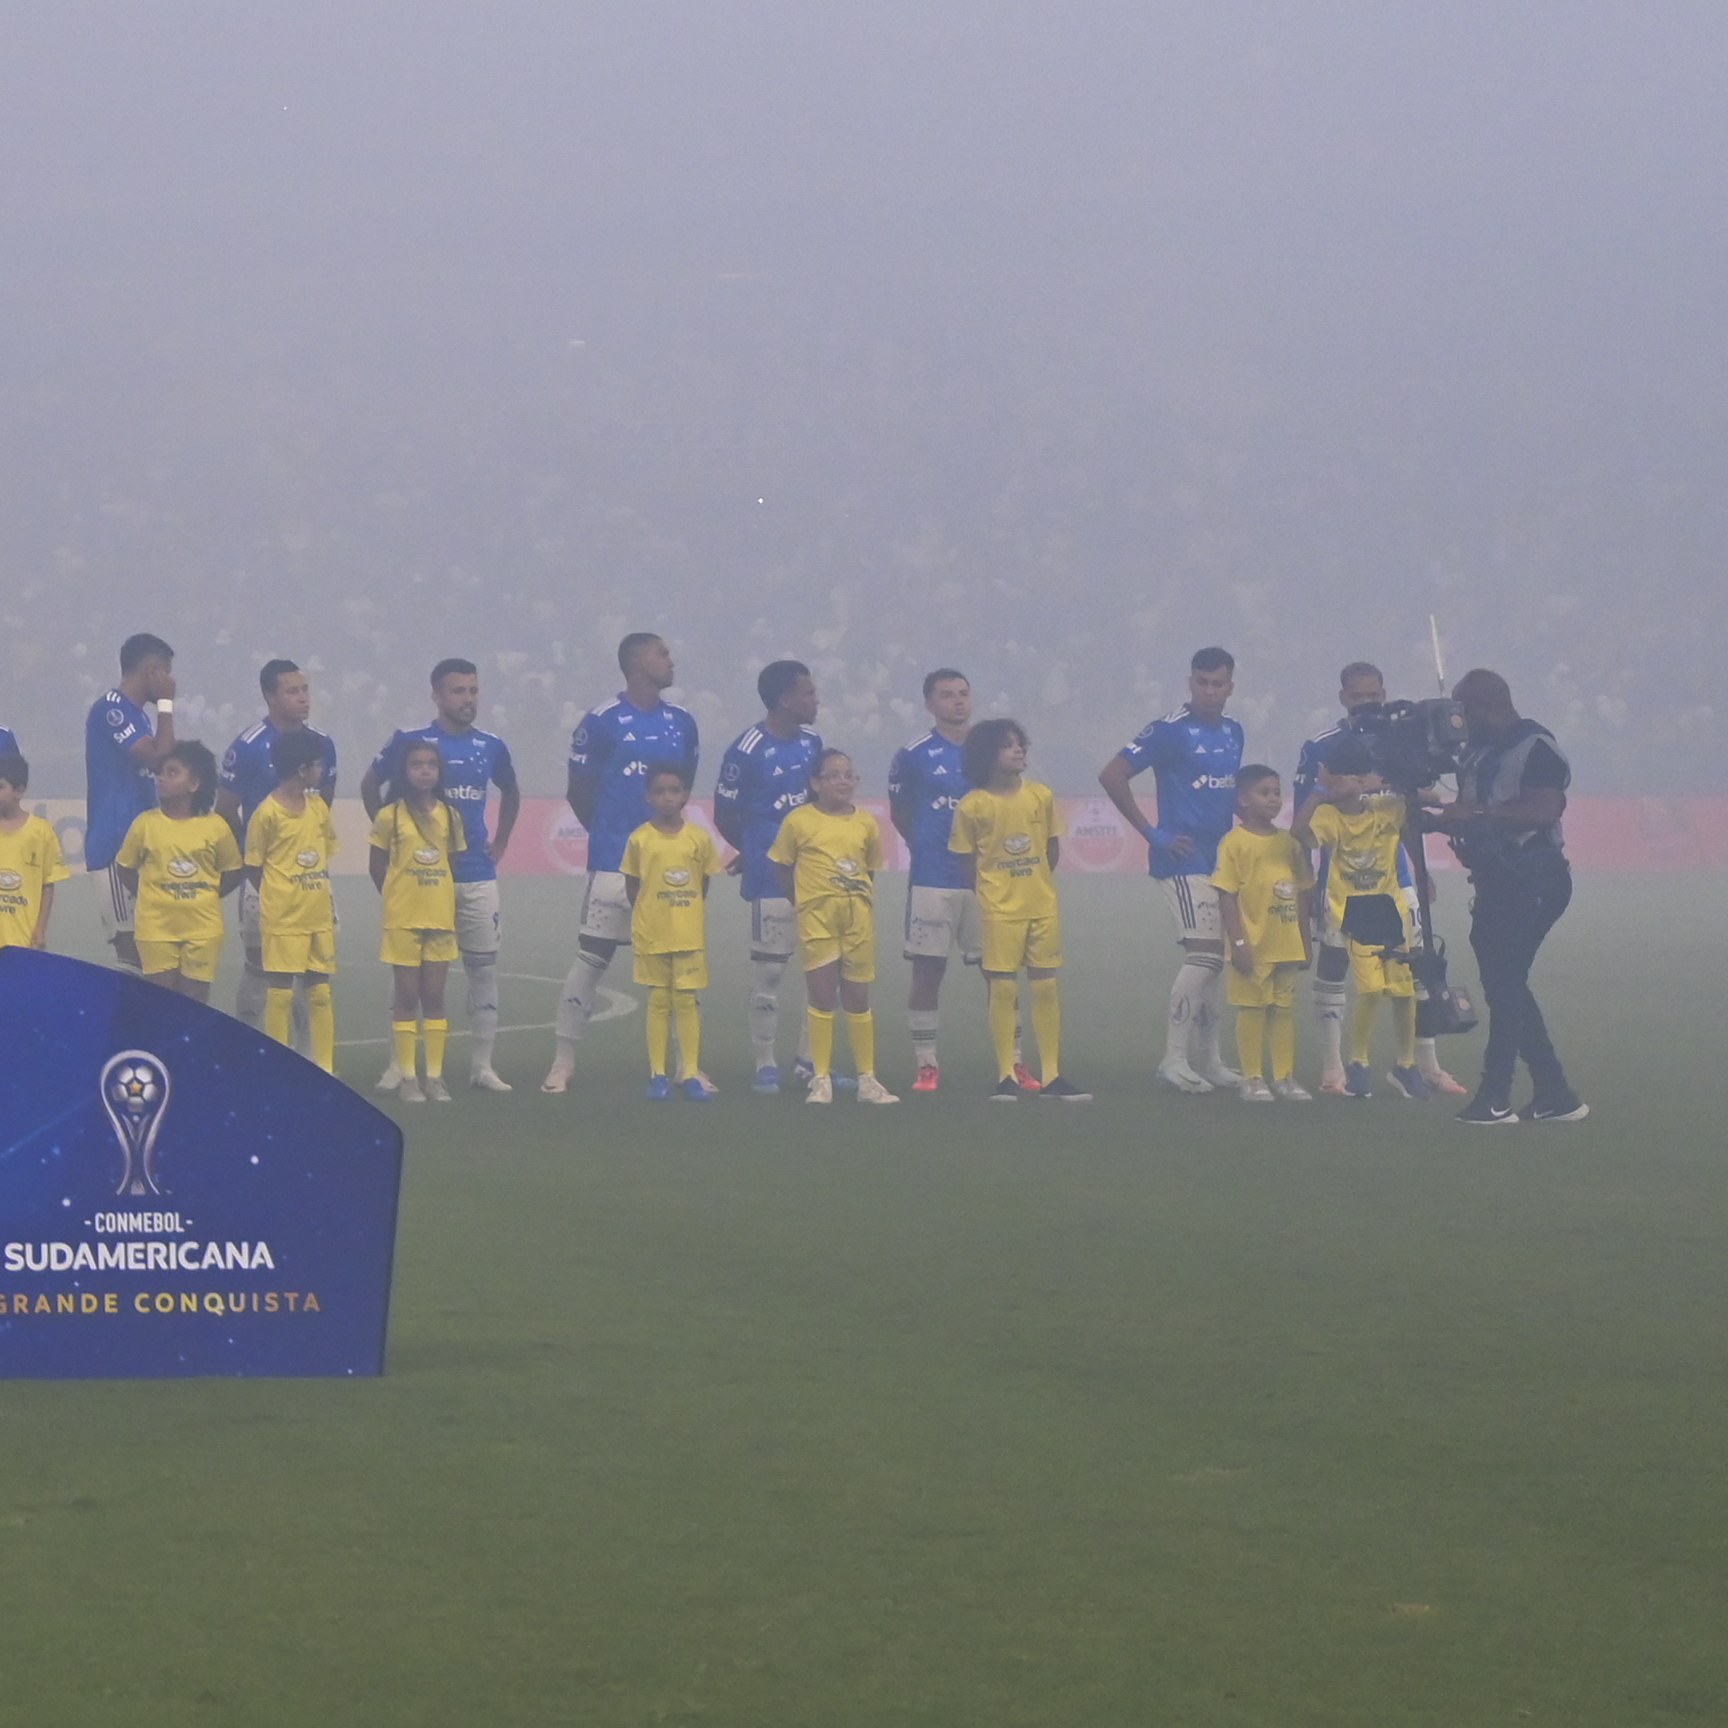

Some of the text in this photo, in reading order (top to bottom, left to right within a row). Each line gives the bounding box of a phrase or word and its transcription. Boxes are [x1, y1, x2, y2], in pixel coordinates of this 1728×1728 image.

[1268, 904, 1295, 915] merc
[95, 1212, 185, 1233] CONMEBOL
[4, 1241, 275, 1271] SUDAMERICANA
[134, 1292, 321, 1316] CONQUISTA
